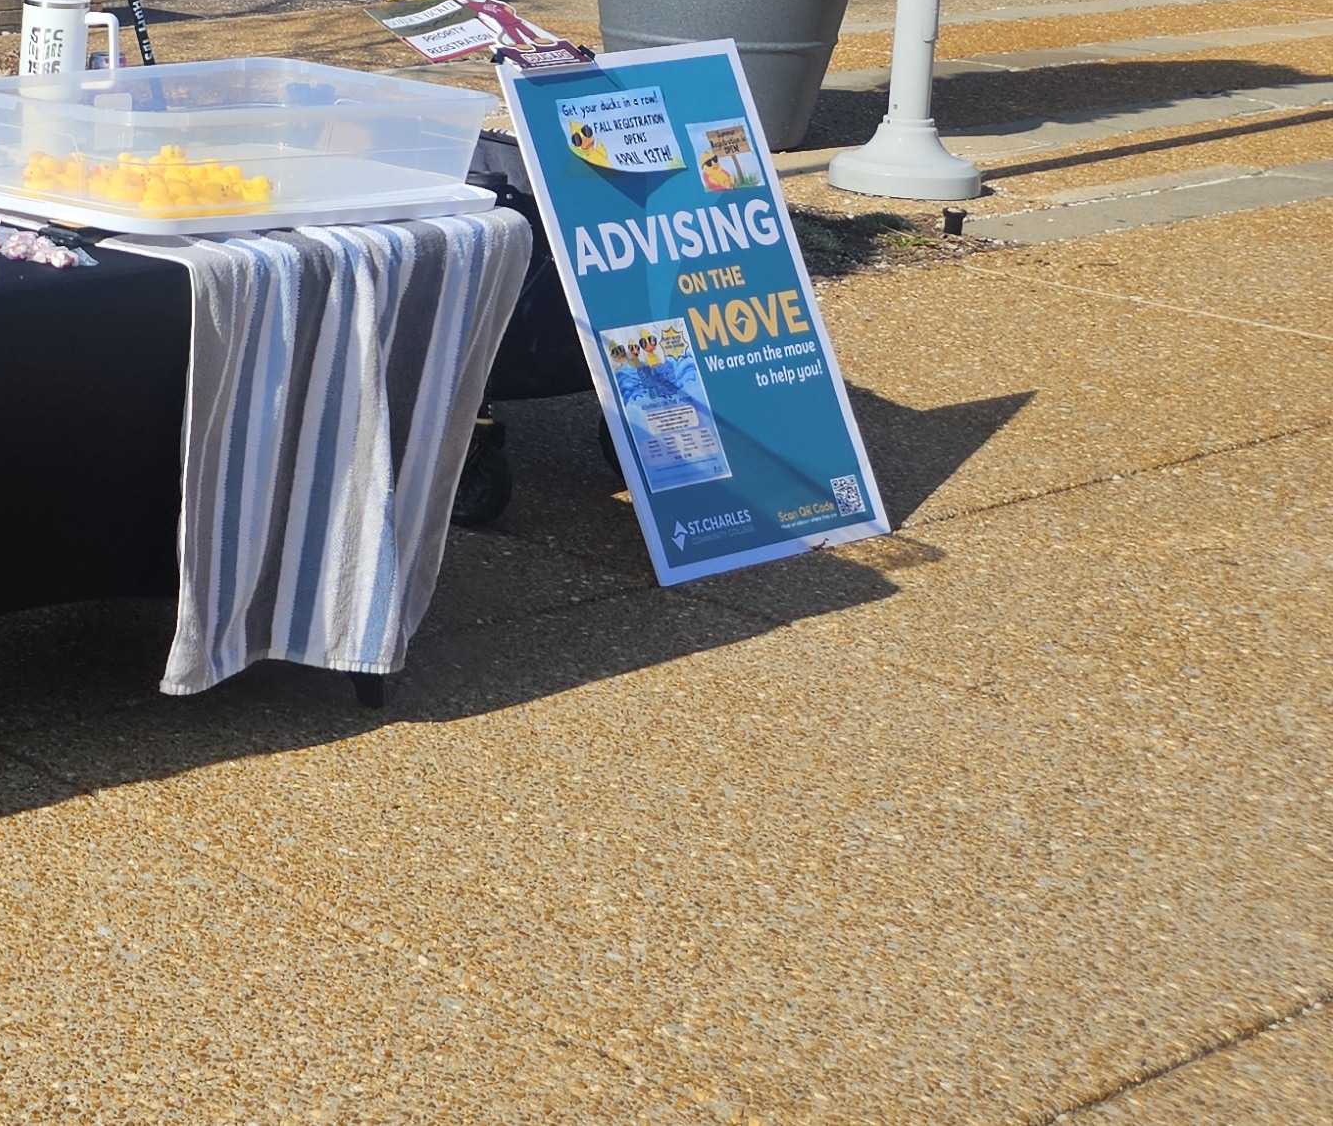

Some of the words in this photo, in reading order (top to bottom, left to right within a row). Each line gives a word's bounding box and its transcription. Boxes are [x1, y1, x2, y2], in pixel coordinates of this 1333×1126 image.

[30, 27, 63, 44] SCC
[421, 26, 467, 42] PRIORITY
[427, 33, 493, 55] REGISTRATION
[522, 50, 574, 63] COUGARS
[562, 104, 577, 116] Get
[580, 107, 597, 118] your
[601, 99, 621, 110] ducks
[623, 97, 631, 106] in
[641, 91, 658, 105] row!
[594, 122, 613, 134] FALL
[613, 113, 665, 130] REGISTRATION
[623, 132, 647, 145] OPENS
[615, 151, 644, 166] APRIL
[644, 145, 673, 164] 13TH!
[575, 198, 780, 275] ADVISING
[678, 271, 708, 295] ON
[708, 265, 745, 289] THE
[687, 289, 809, 350] MOVE
[705, 355, 725, 372] We
[726, 354, 745, 368] are
[747, 351, 762, 364] on
[762, 345, 782, 361] the
[784, 340, 816, 357] move
[756, 372, 769, 387] to
[769, 365, 795, 385] help
[797, 359, 823, 382] you!
[777, 511, 799, 522] Scan
[799, 506, 813, 517] QR
[813, 500, 835, 513] Code
[692, 531, 727, 545] COMMUNITY
[728, 523, 756, 537] COLLEGE
